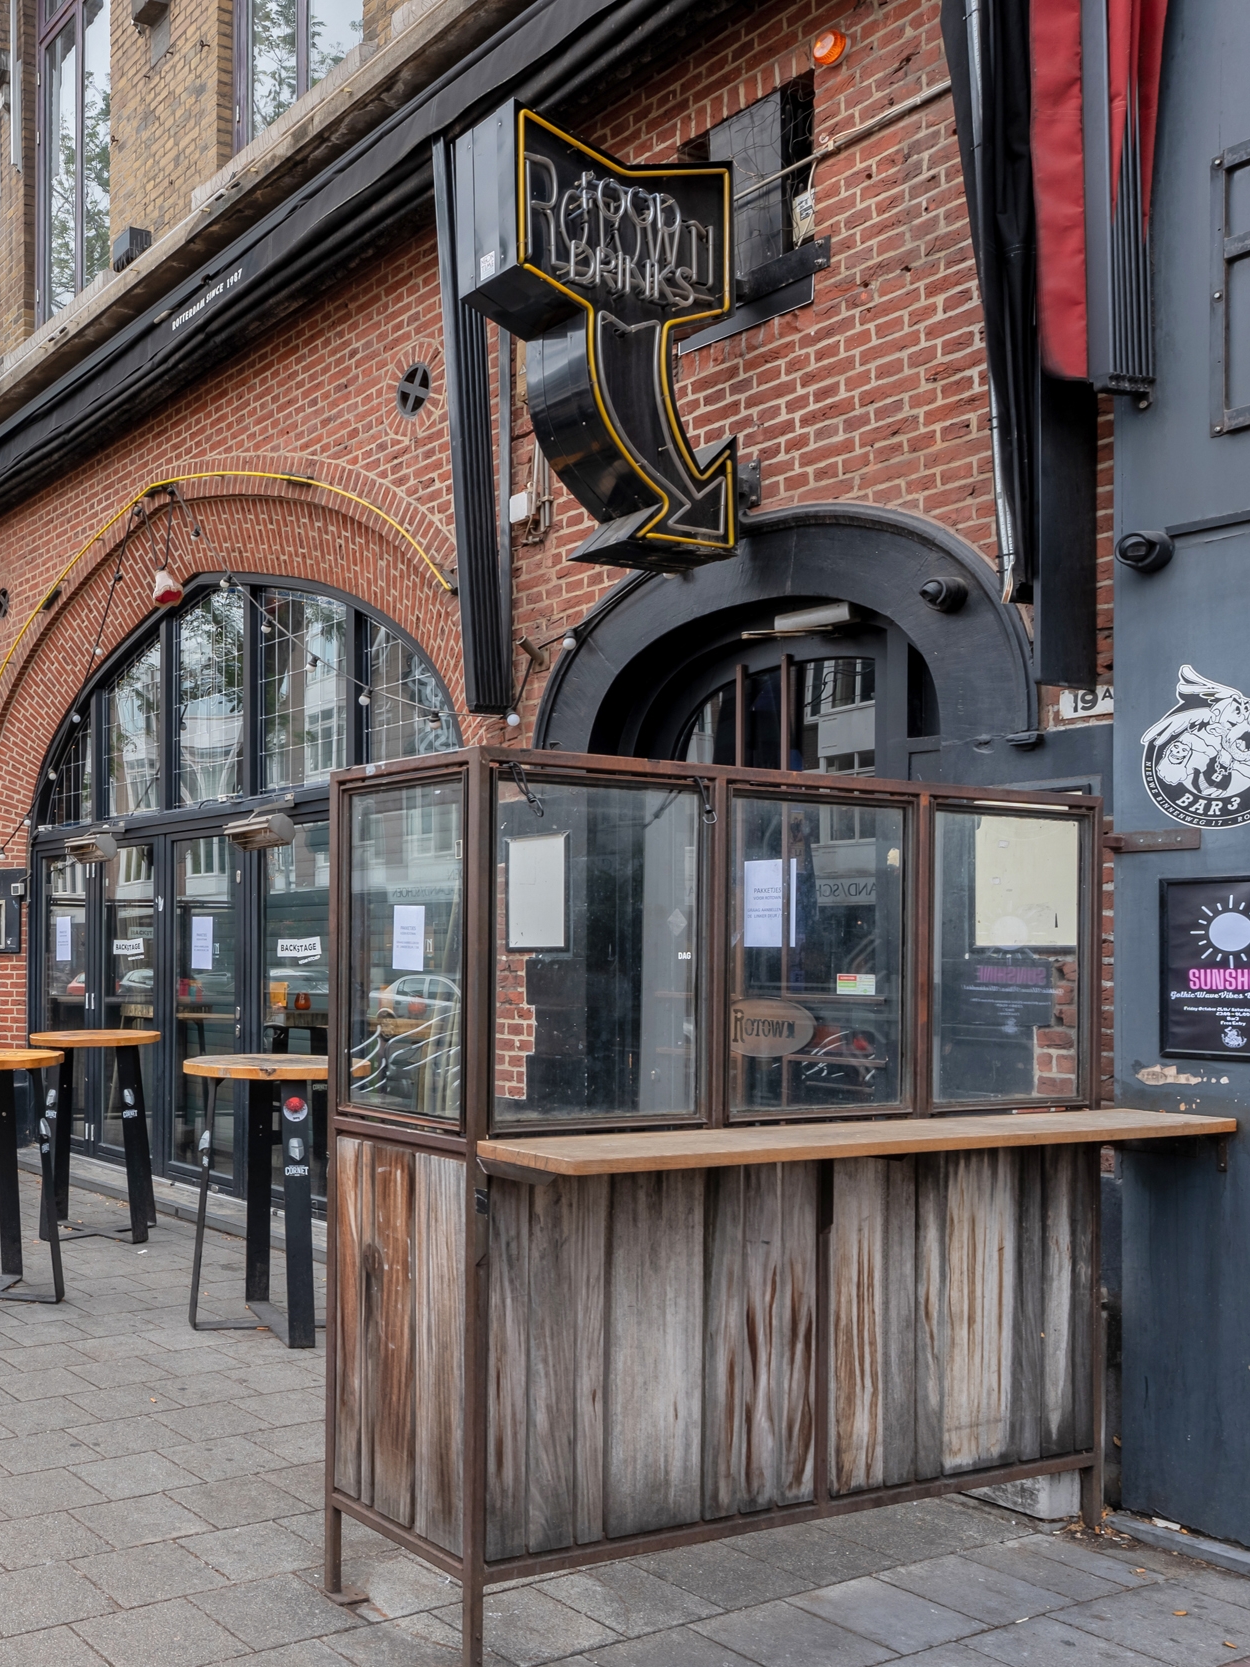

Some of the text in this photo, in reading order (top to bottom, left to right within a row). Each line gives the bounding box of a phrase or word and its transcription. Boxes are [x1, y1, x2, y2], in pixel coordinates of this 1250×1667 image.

[570, 240, 694, 307] DRINKS
[171, 267, 243, 331] ROTTERDAM SINCE 1987
[1145, 761, 1159, 794] NIEUWE
[1156, 796, 1206, 825] BINNENWEG
[1175, 792, 1241, 815] BAR 3
[115, 942, 141, 951] BACKSTAGE
[280, 942, 317, 953] BACKSTAGE
[678, 952, 691, 960] DAG
[1170, 991, 1195, 1000] Gothic
[1195, 991, 1219, 999] Wave
[1218, 990, 1244, 999] Vibes
[284, 1166, 309, 1176] CORNET
